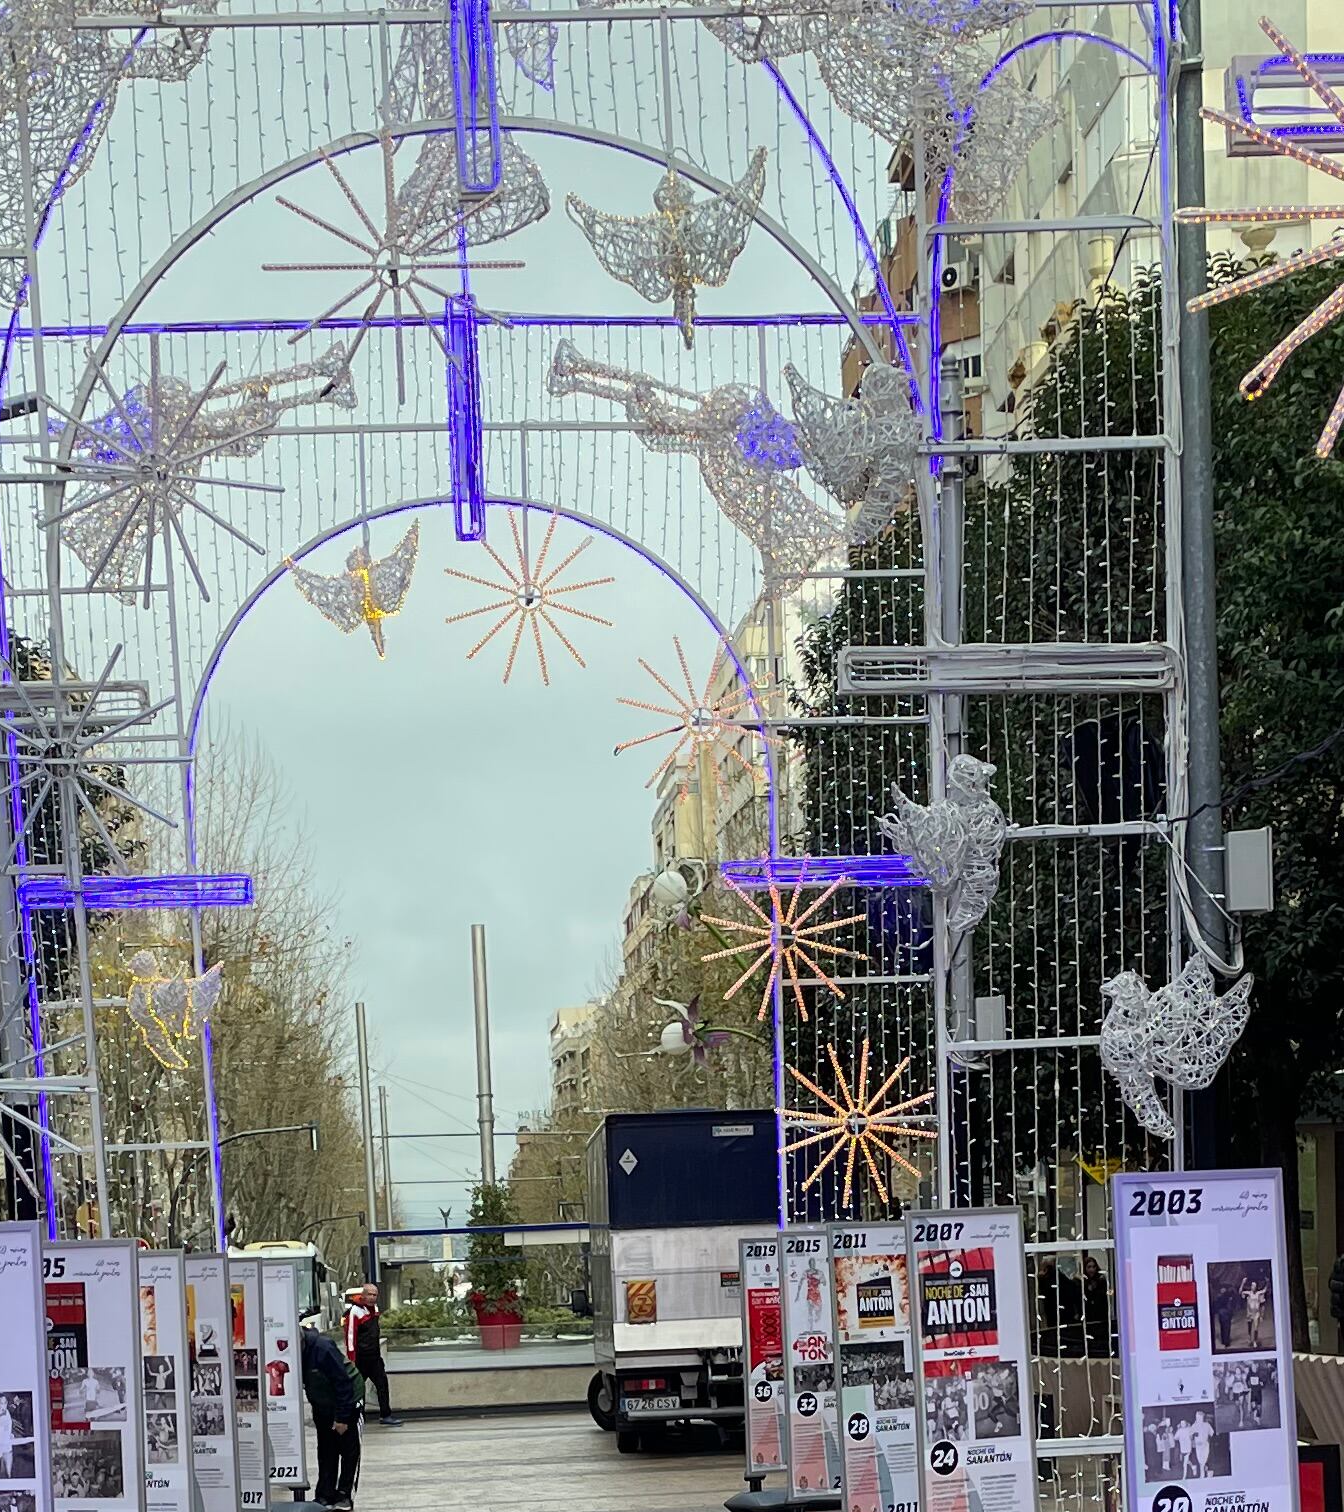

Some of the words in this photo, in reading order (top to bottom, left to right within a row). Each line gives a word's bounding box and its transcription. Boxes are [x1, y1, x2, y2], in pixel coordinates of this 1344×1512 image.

[1129, 1189, 1203, 1216] 2003
[913, 1223, 964, 1242] 2007
[786, 1239, 821, 1253] 2015
[834, 1233, 867, 1249] 2011
[746, 1245, 776, 1257] 2019
[925, 1286, 952, 1300] NOCHE
[953, 1284, 964, 1297] DE
[969, 1284, 989, 1297] SAN
[927, 1294, 991, 1326] ANTÓN
[756, 1386, 771, 1397] 36
[800, 1398, 816, 1411] 32
[850, 1420, 868, 1434] 28
[932, 1449, 955, 1468] 24
[269, 1467, 297, 1478] 2021
